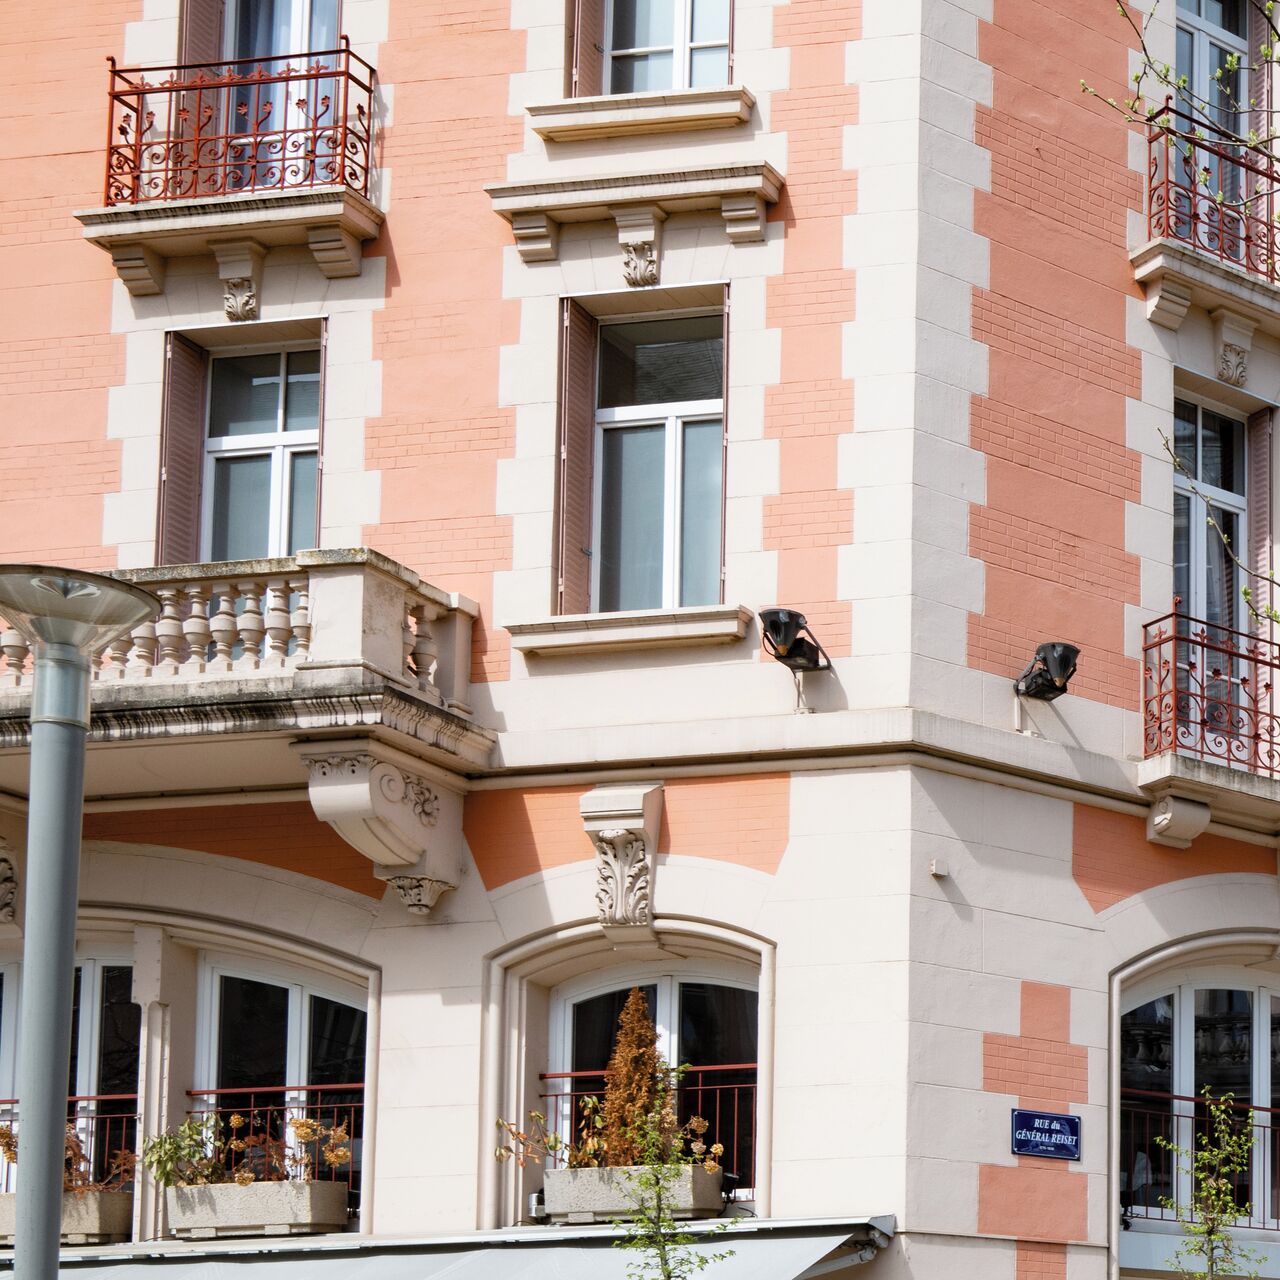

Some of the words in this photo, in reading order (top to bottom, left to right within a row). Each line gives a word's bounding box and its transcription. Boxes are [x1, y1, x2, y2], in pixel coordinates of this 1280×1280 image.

[1034, 1119, 1049, 1128] RUE
[1051, 1121, 1060, 1129] du
[1016, 1129, 1049, 1141] GÉNÉRAL
[1051, 1134, 1077, 1145] REISET
